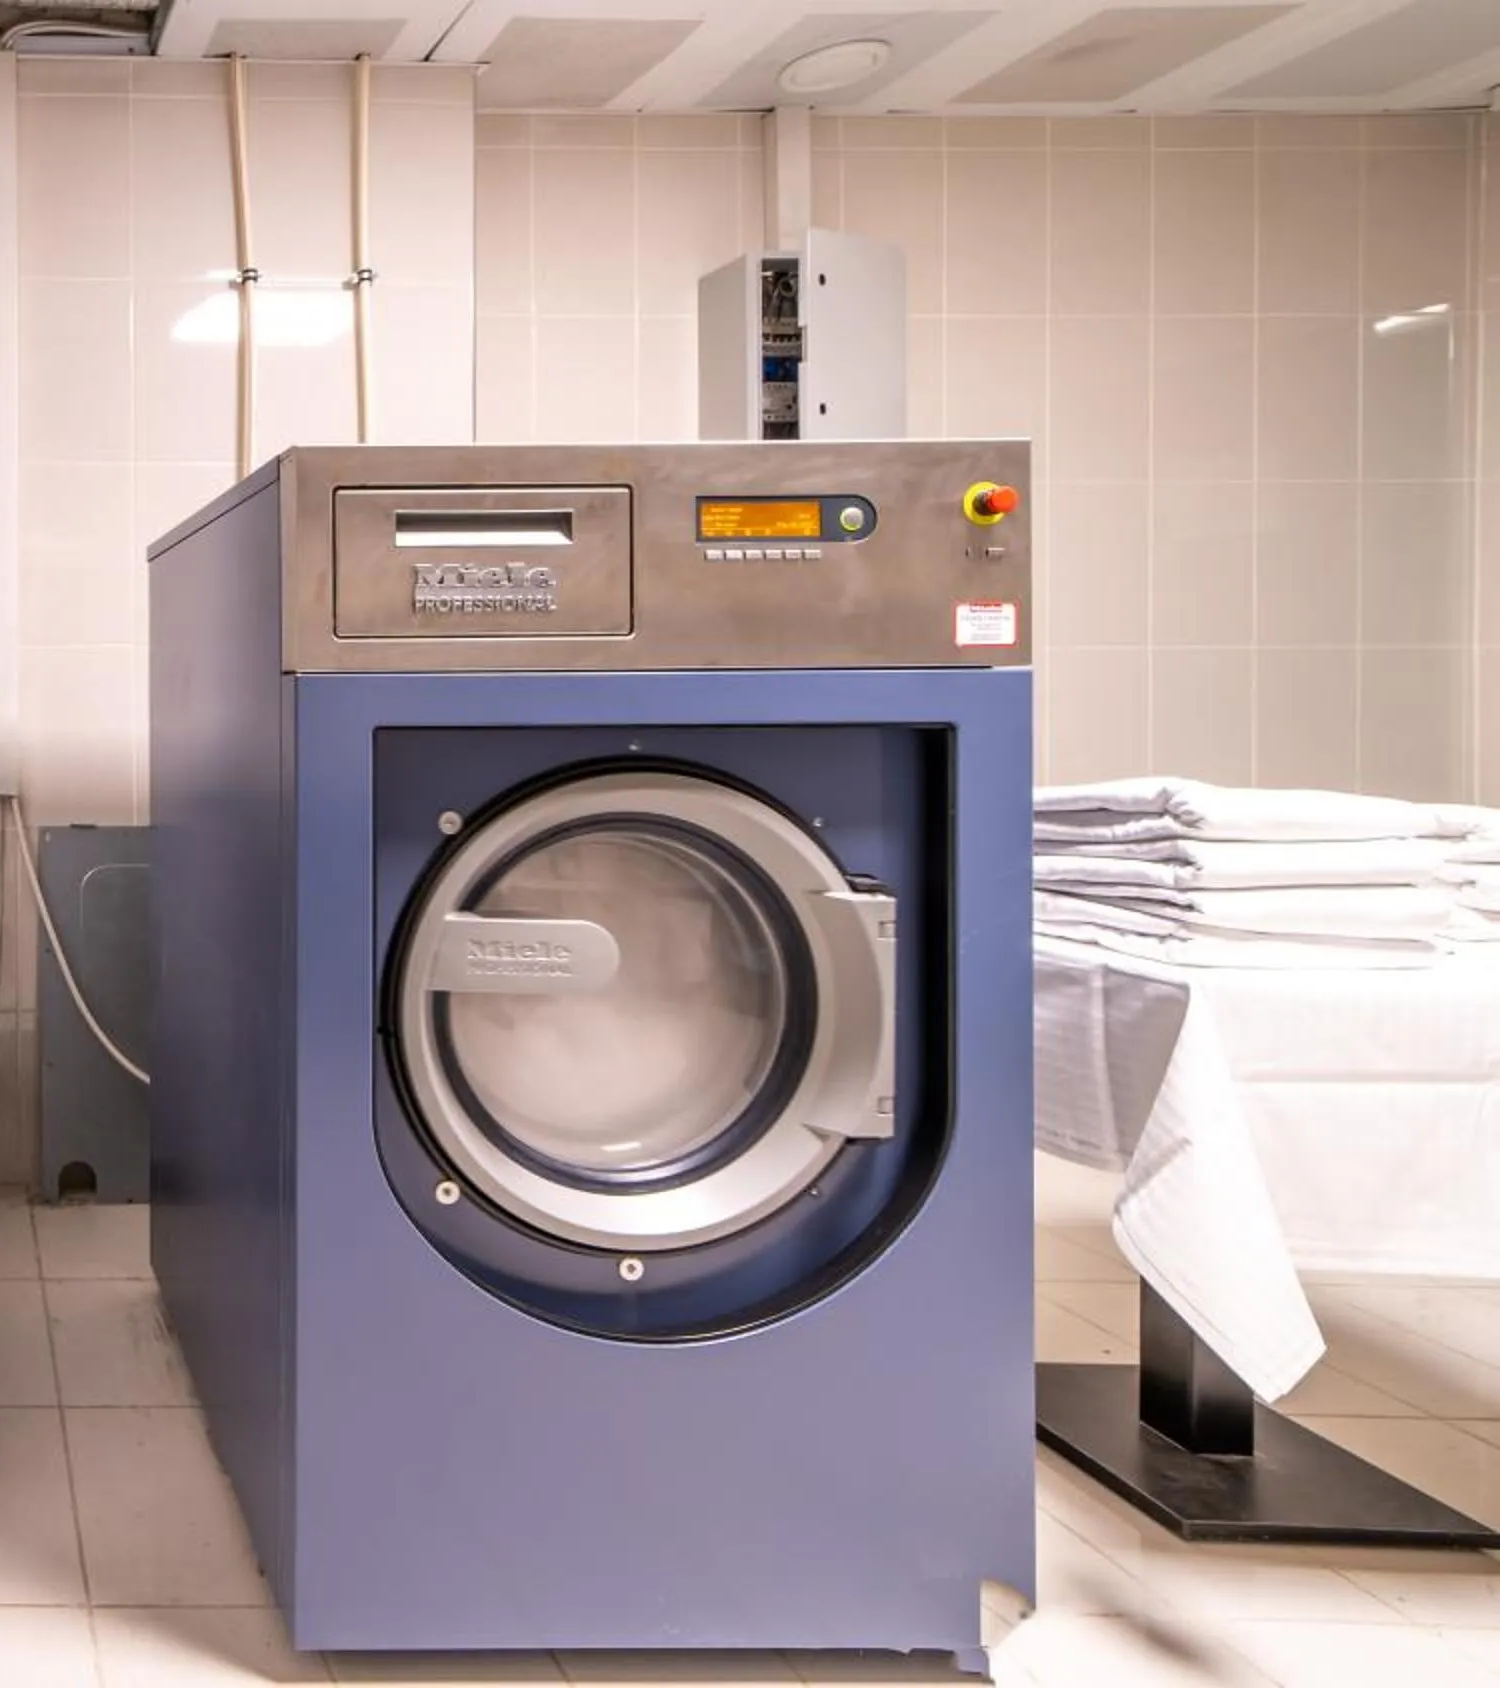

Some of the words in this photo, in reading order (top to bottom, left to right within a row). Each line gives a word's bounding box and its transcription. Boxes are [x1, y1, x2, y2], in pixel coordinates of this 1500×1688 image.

[413, 562, 556, 588] Miele
[412, 594, 557, 613] PROFESSIONAL
[467, 939, 572, 961] Miele
